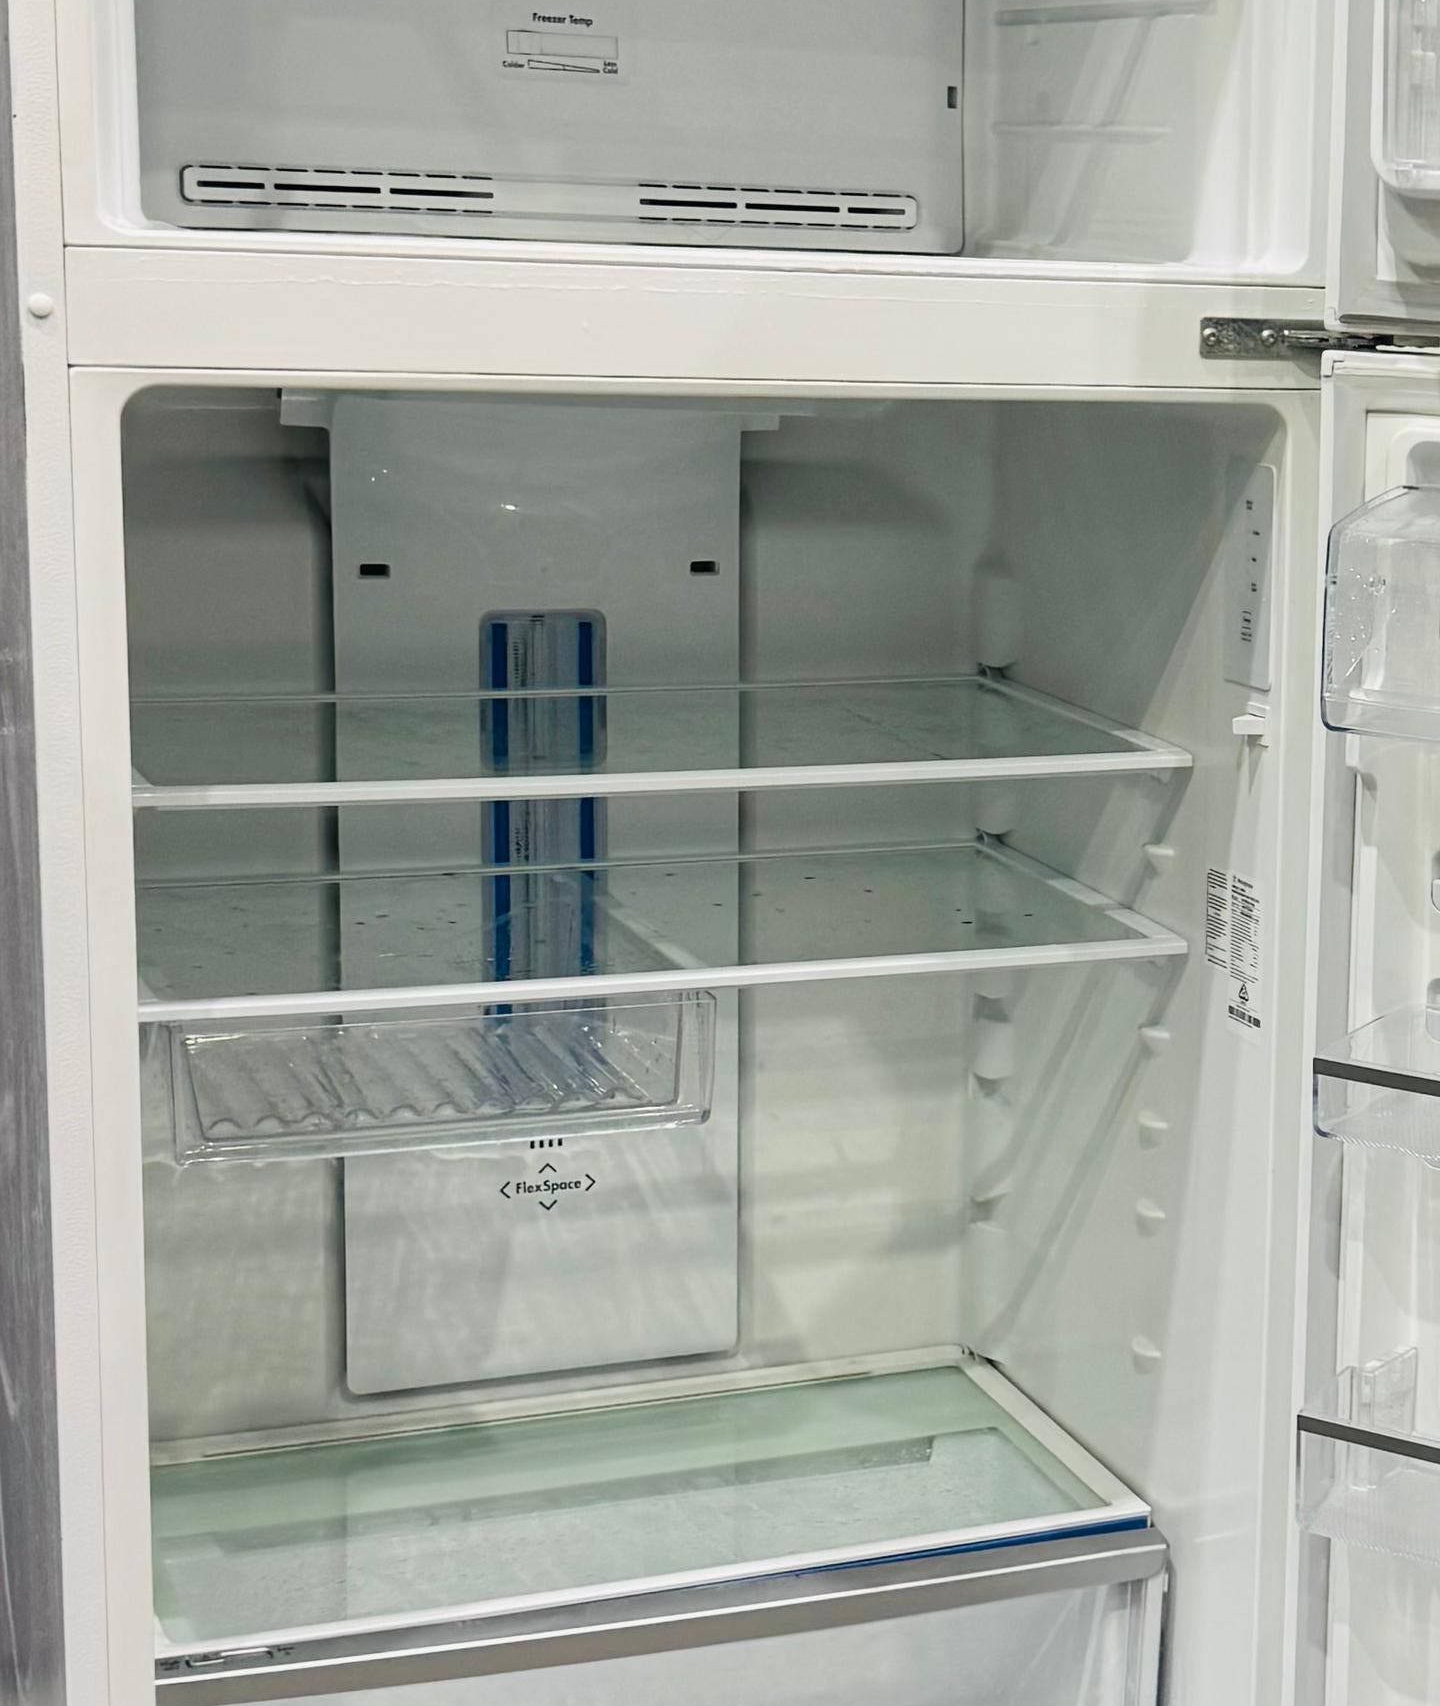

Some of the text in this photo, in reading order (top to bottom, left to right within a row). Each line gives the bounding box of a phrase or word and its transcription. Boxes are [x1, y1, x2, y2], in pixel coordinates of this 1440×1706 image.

[532, 12, 594, 28] Freezer Temp
[515, 1179, 582, 1195] FlexSpace
